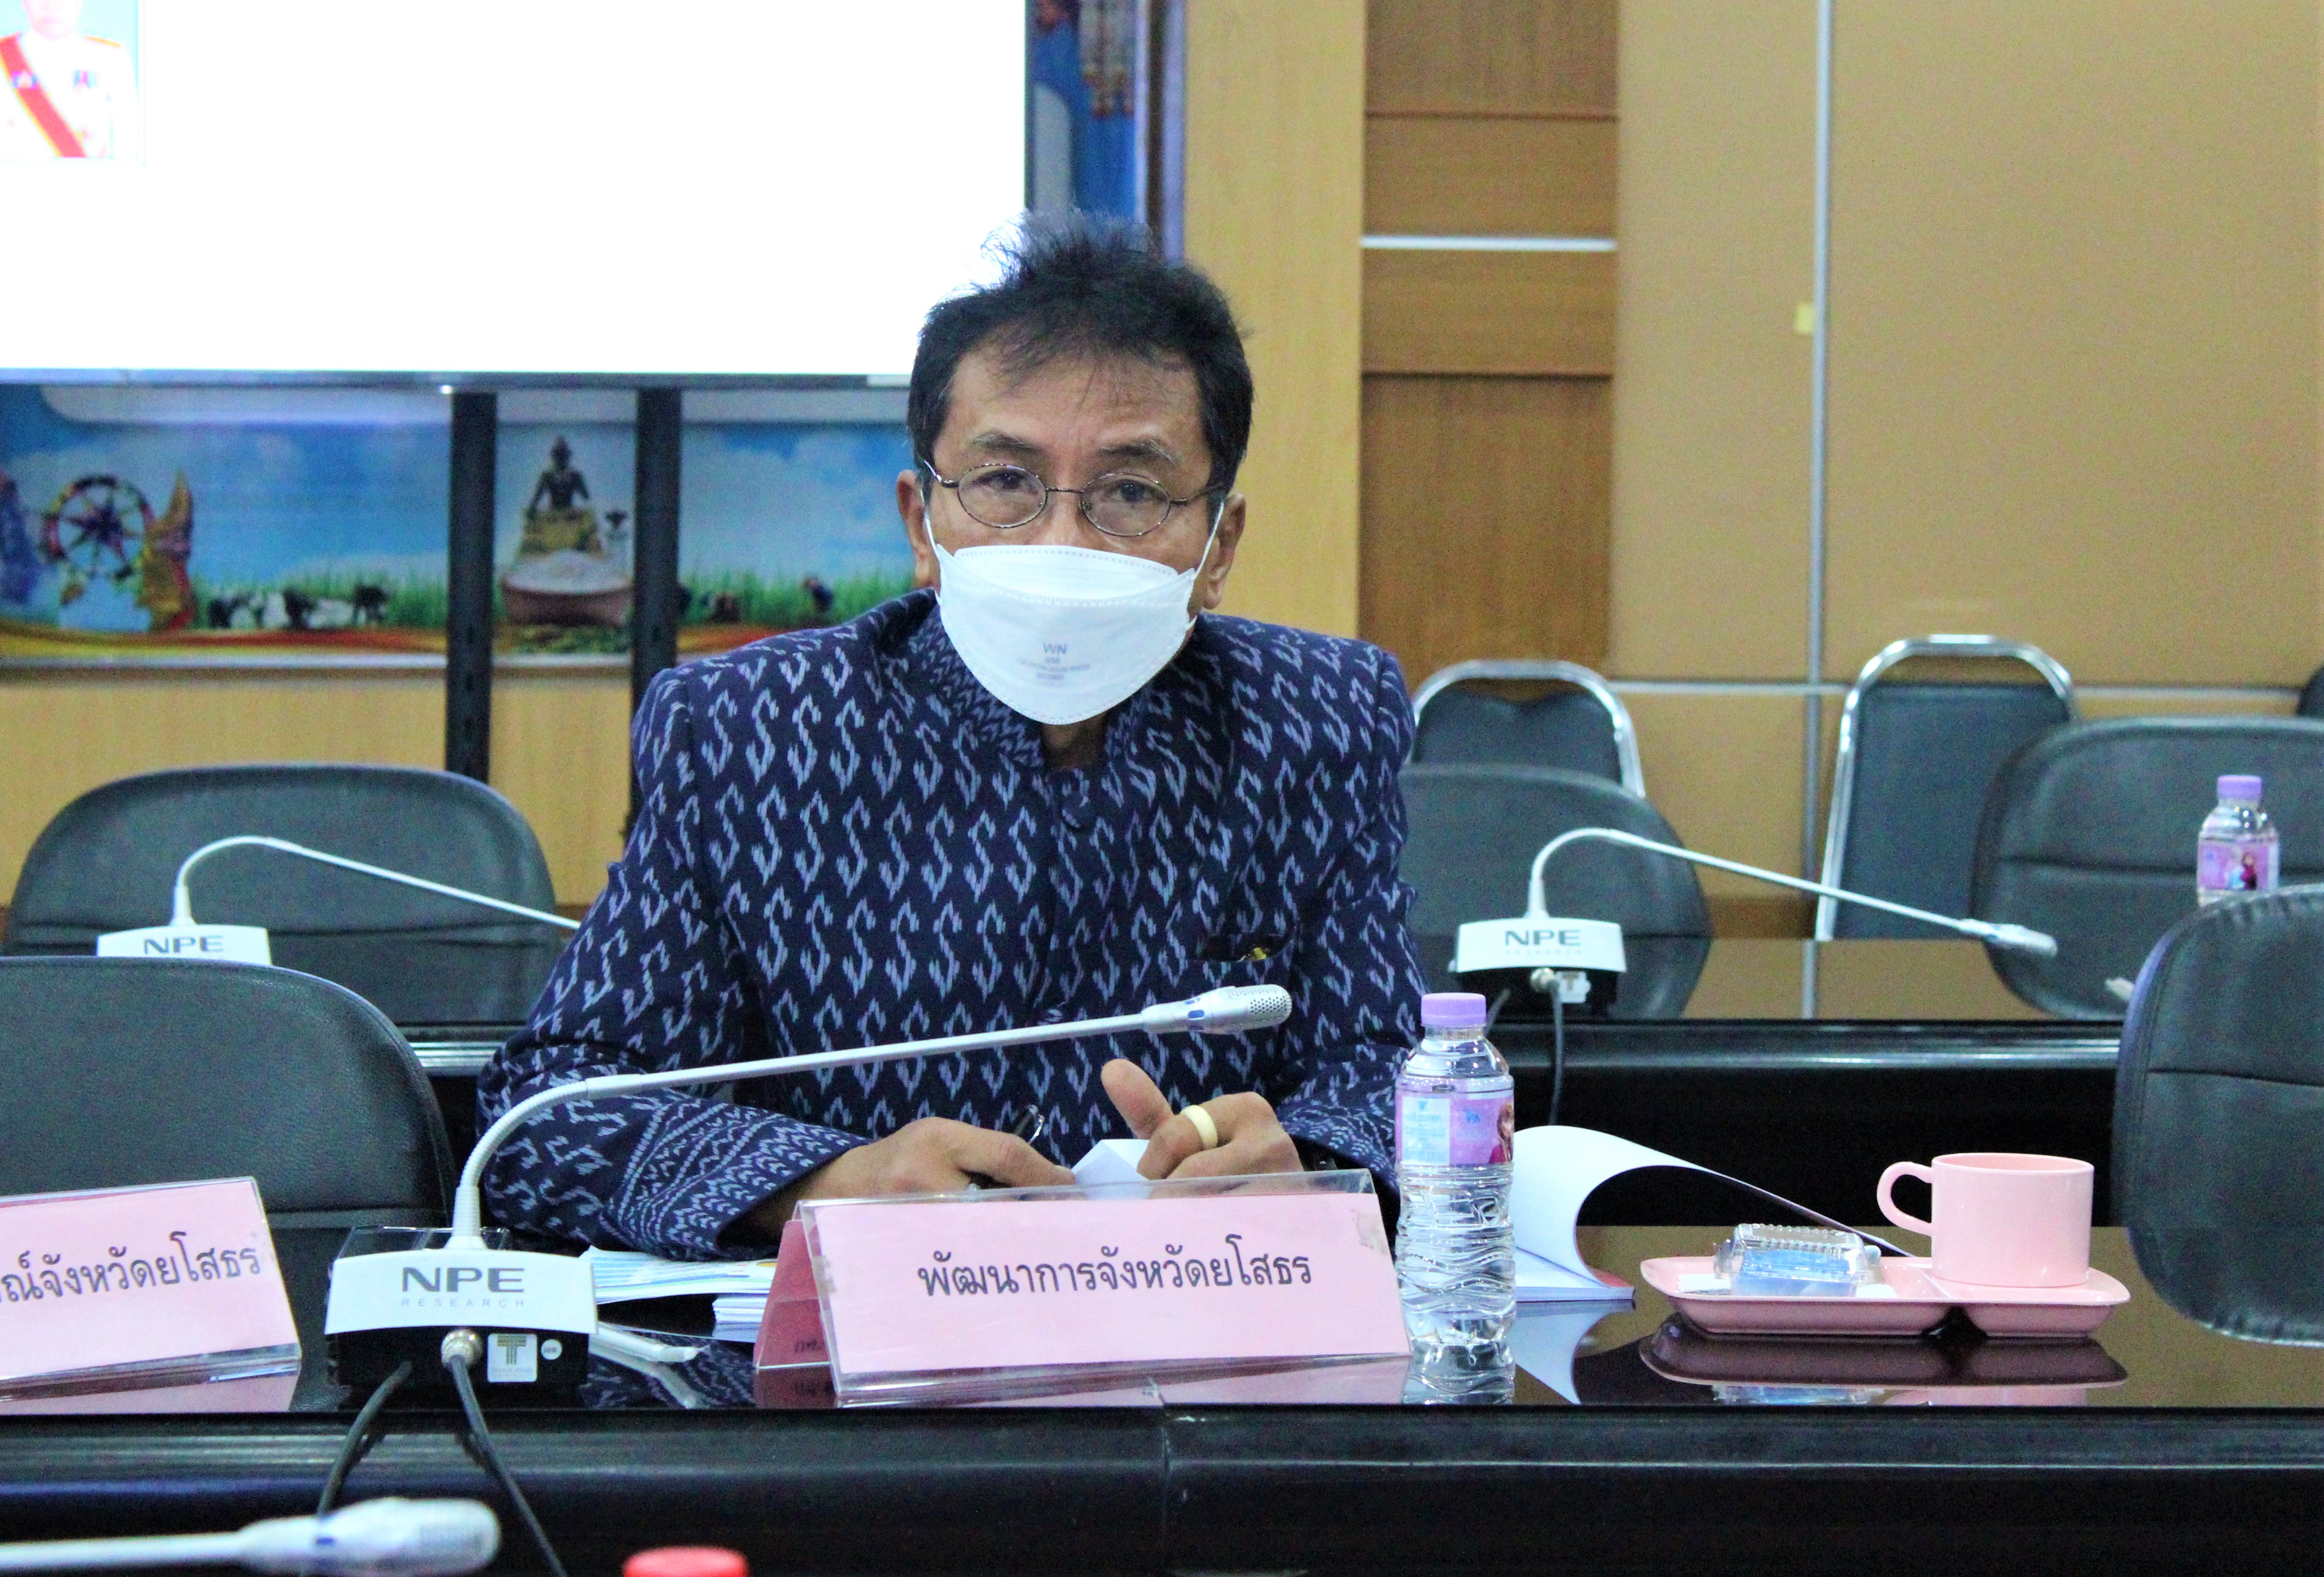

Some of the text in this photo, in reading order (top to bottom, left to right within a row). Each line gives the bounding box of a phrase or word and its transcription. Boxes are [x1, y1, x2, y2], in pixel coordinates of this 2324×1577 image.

[1043, 643, 1067, 655] WN
[144, 935, 223, 954] NPE
[1505, 930, 1580, 946] NPE
[0, 1230, 259, 1303] ณ์จังหวัดยโสธร
[917, 1233, 1312, 1297] พัฒนาการจังหวัดยโสธร
[402, 1267, 524, 1293] NPE
[401, 1298, 524, 1308] RESEARCH
